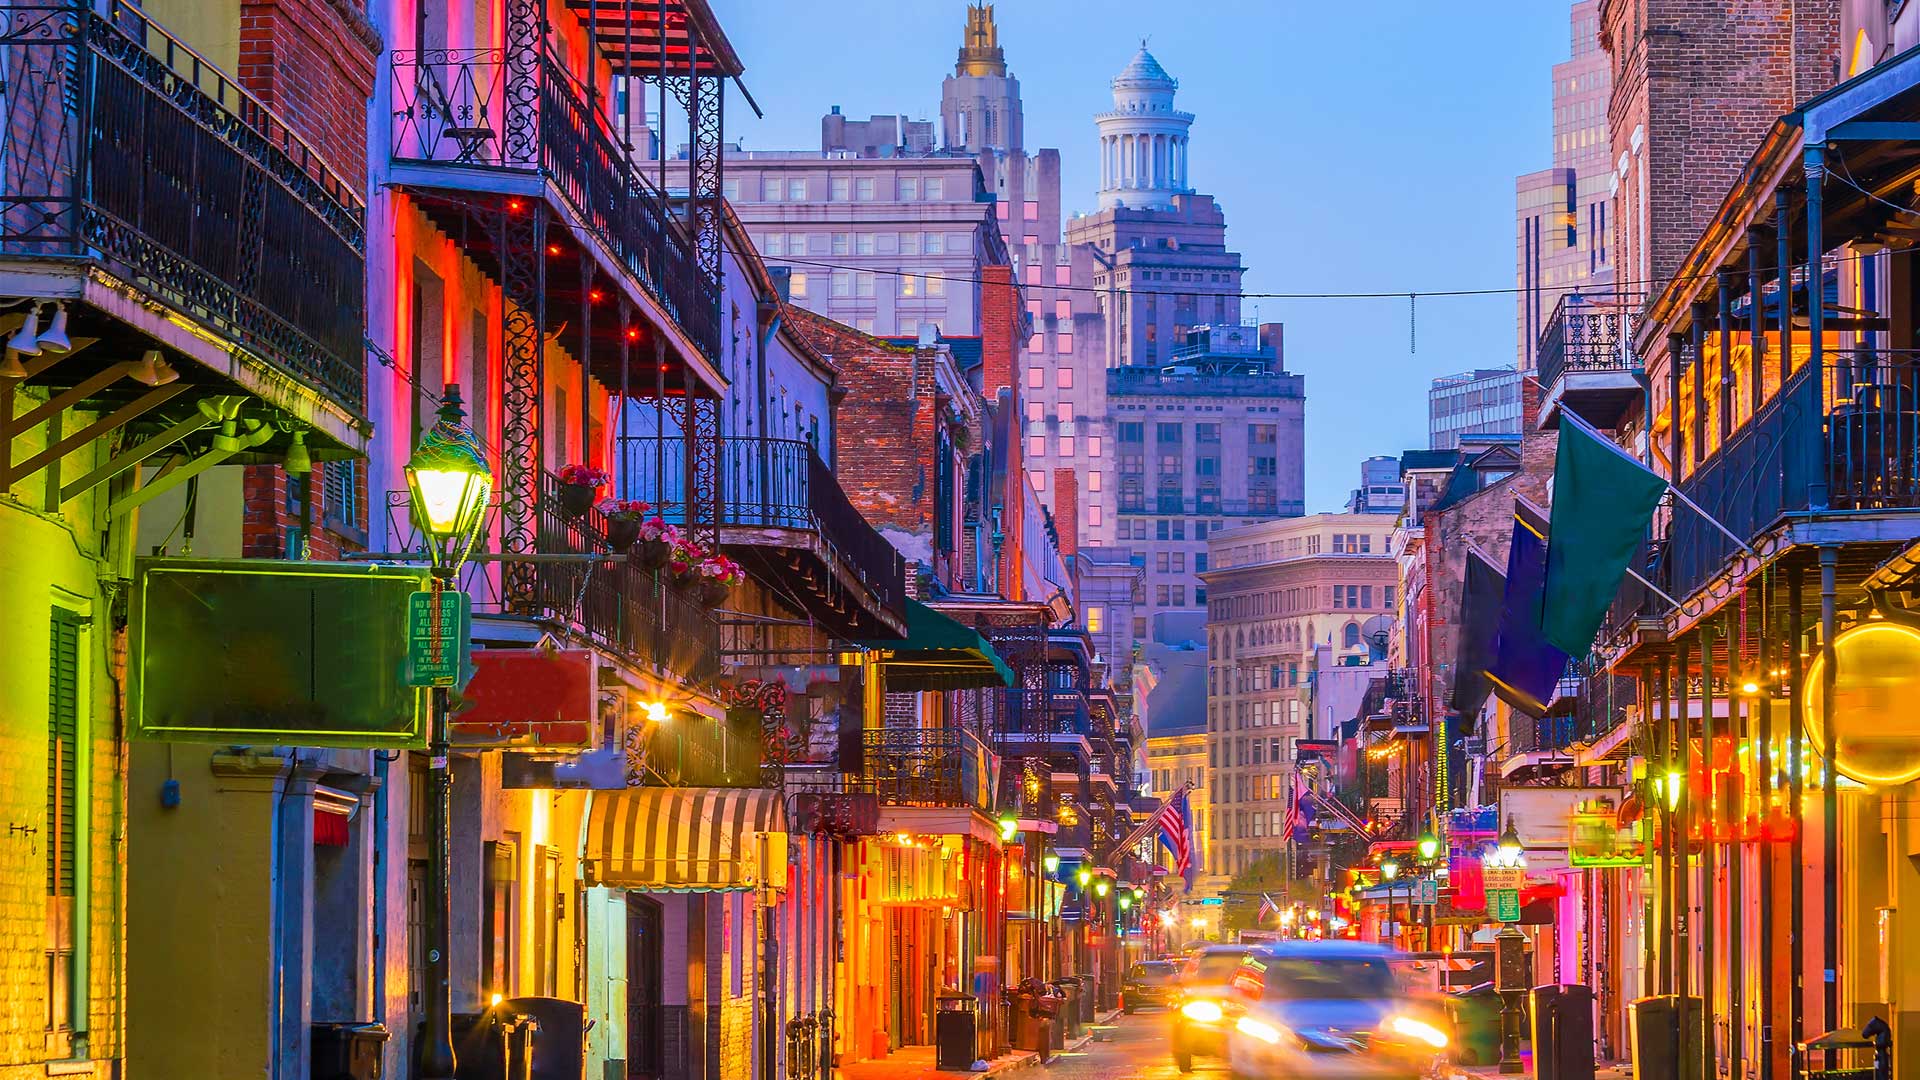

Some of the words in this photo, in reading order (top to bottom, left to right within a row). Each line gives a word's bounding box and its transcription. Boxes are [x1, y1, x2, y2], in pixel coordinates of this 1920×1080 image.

[415, 600, 424, 608] NO
[426, 600, 455, 608] BLES
[418, 609, 427, 617] OR
[429, 609, 451, 617] GSS
[420, 618, 450, 626] ALLED
[415, 627, 425, 635] ON
[428, 627, 452, 635] SEET
